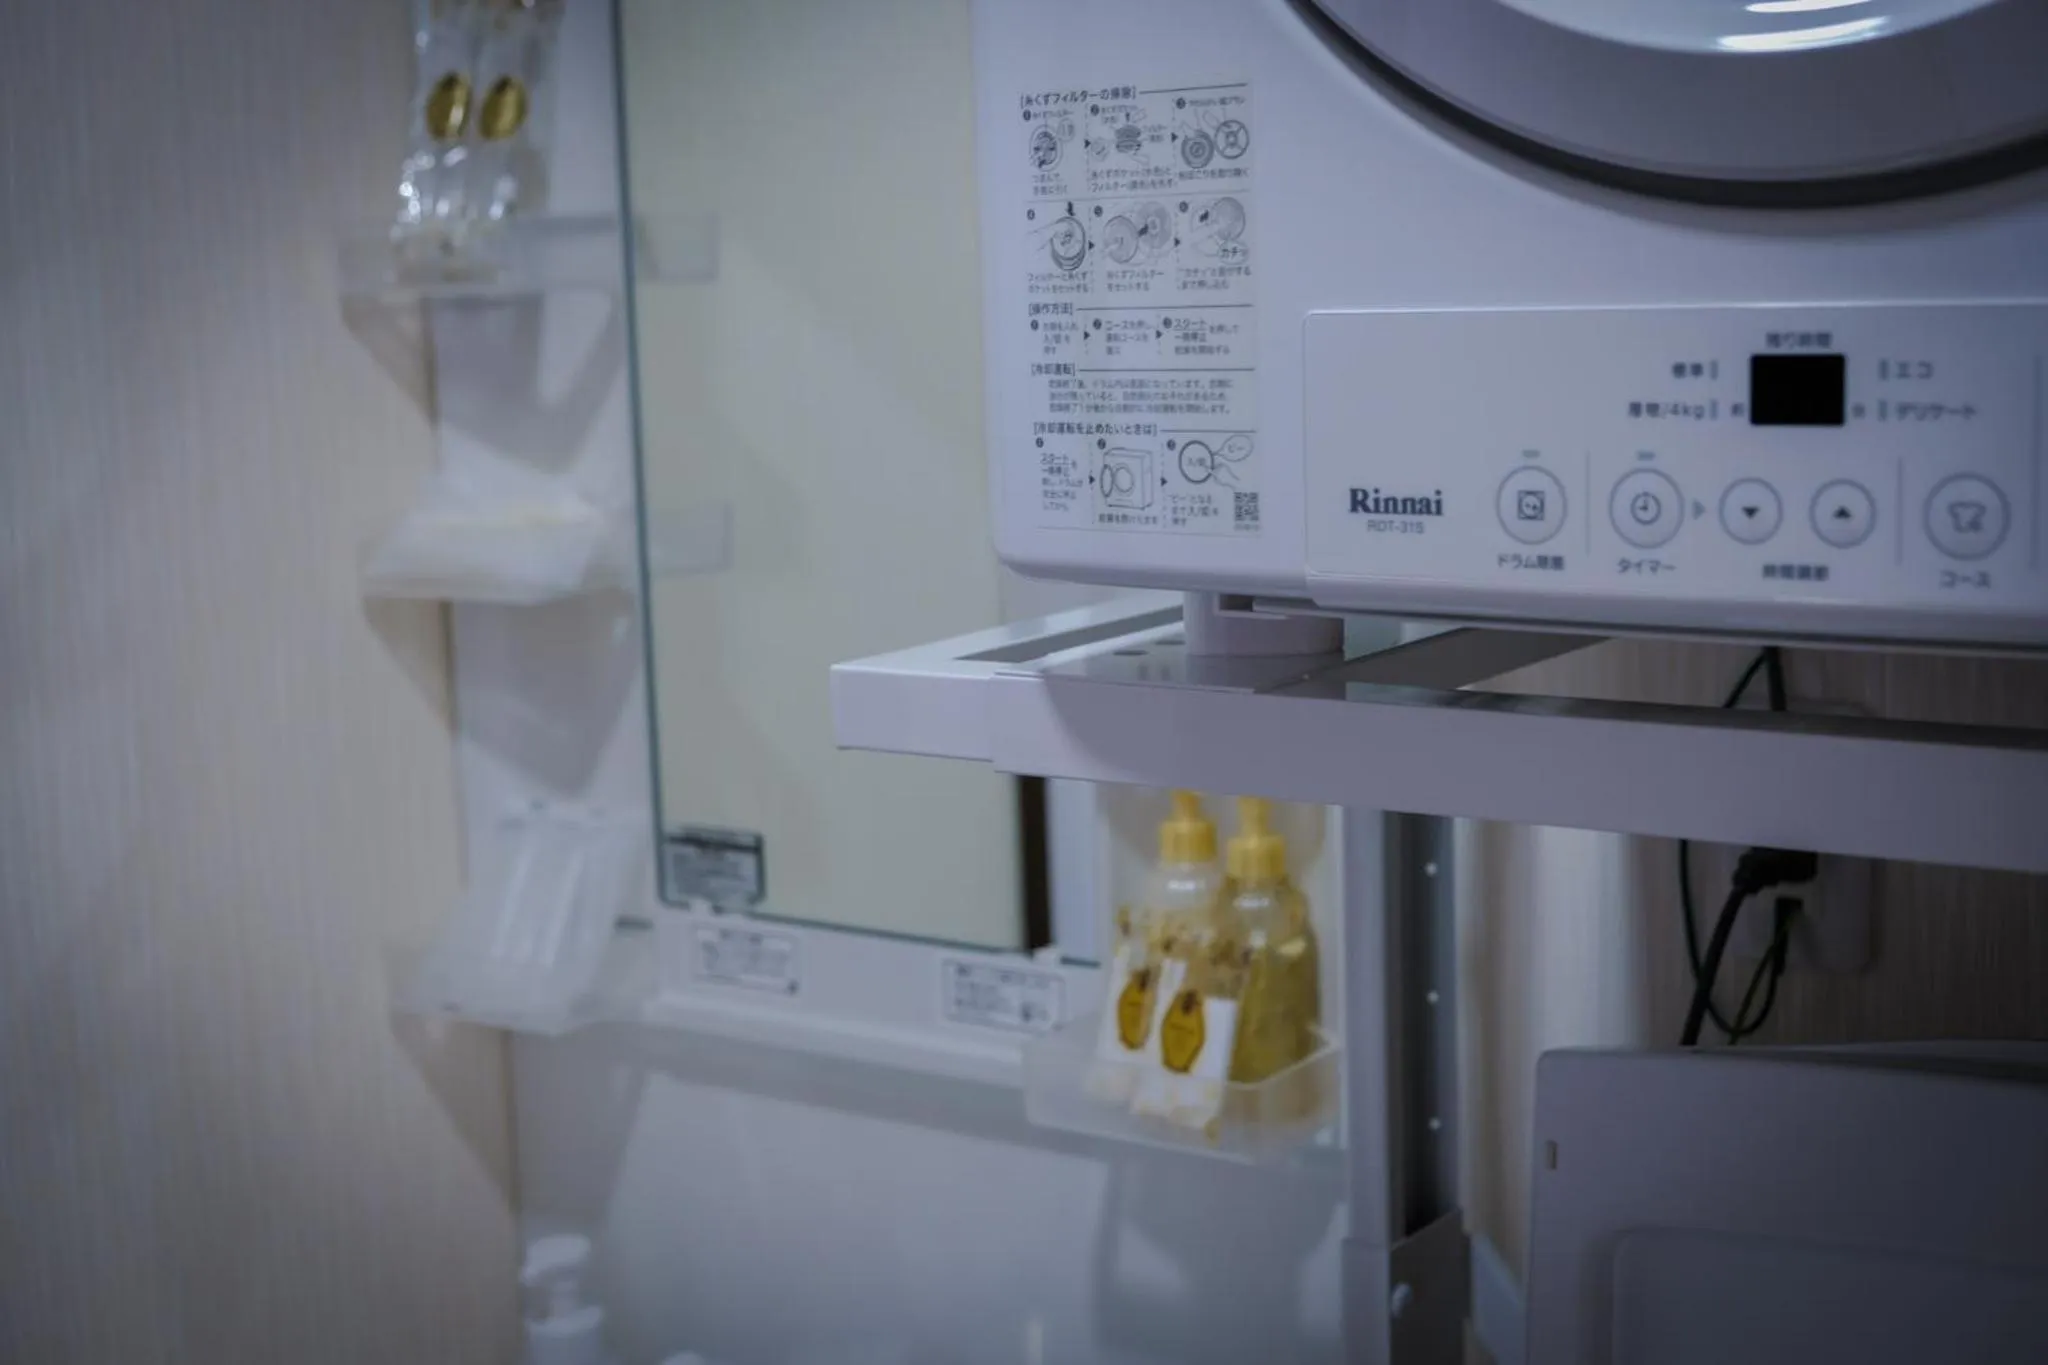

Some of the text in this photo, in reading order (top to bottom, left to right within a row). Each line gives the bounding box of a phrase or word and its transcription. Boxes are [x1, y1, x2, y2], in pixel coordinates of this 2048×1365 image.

[1349, 487, 1444, 516] Rinnai
[1617, 558, 1677, 574] タイマー
